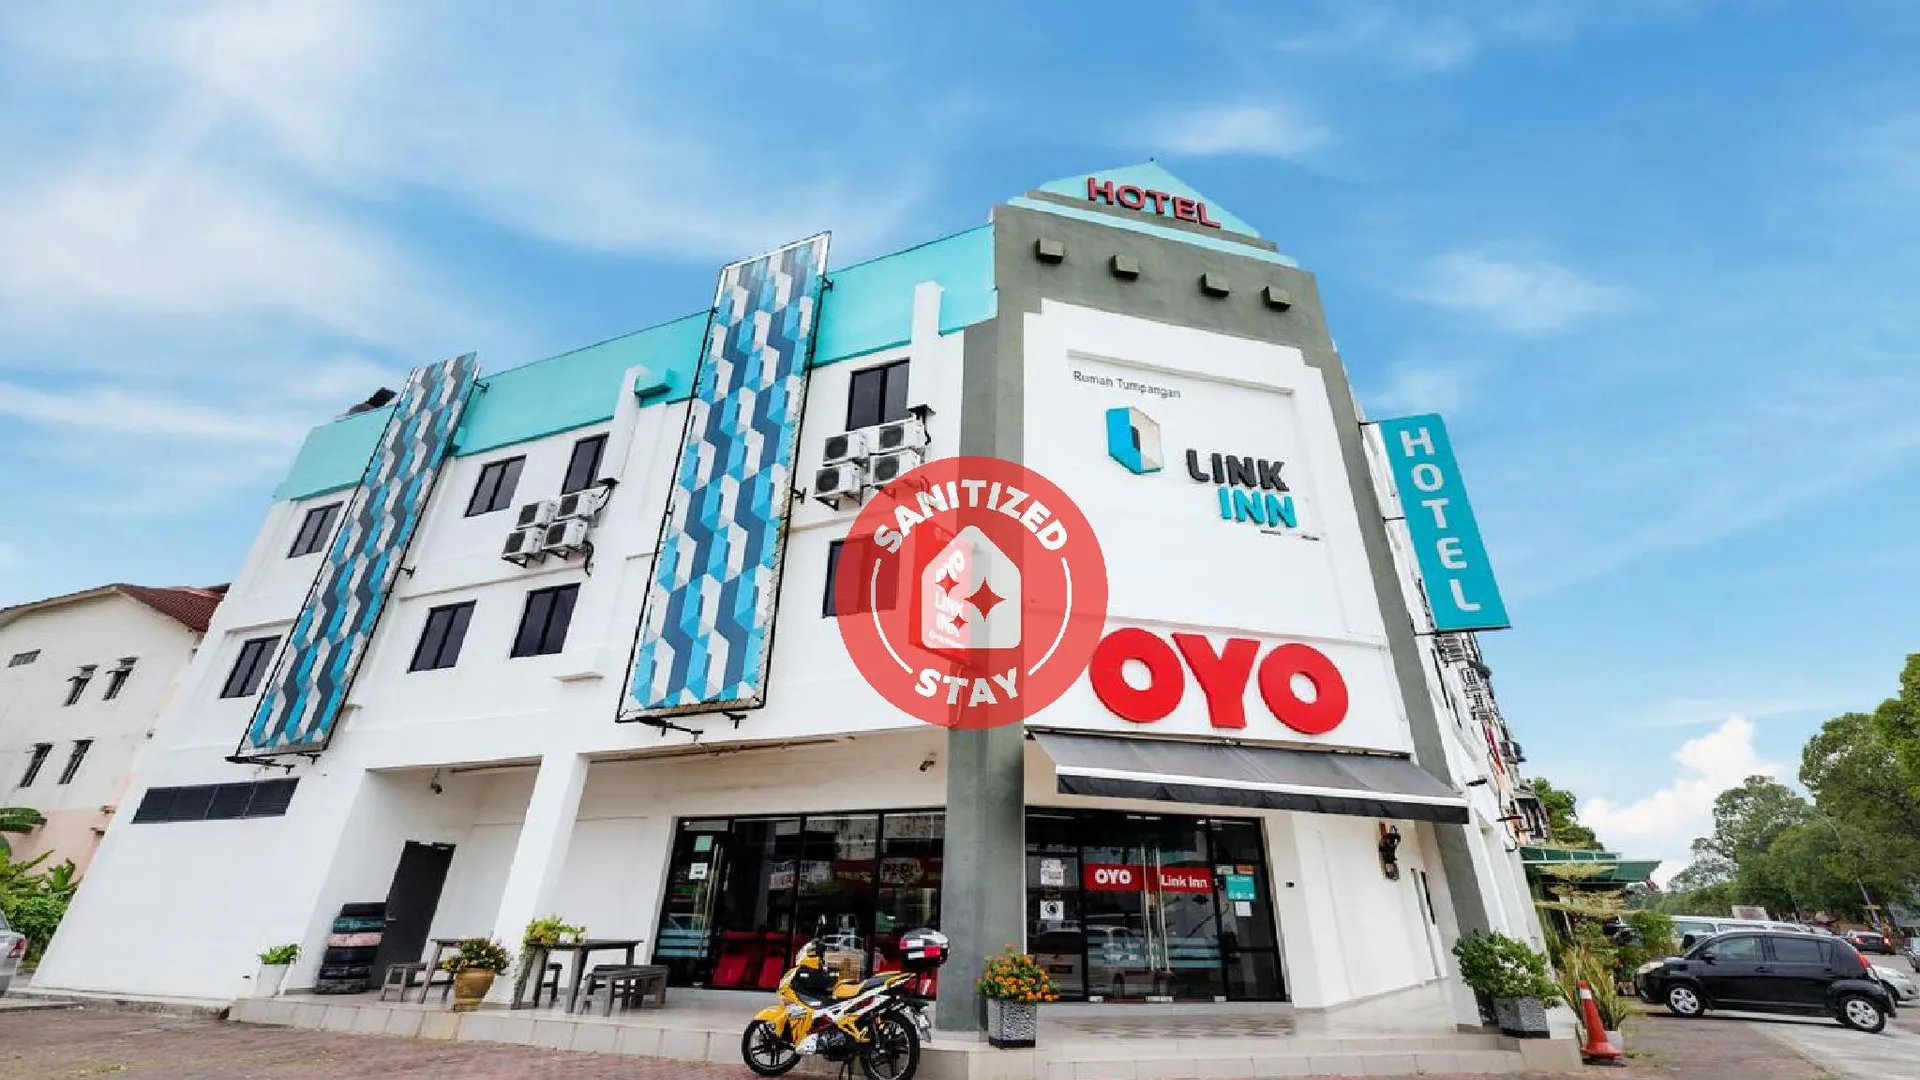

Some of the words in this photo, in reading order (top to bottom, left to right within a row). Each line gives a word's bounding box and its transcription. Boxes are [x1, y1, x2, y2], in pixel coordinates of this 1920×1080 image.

[1087, 177, 1221, 228] HOTEL
[1072, 370, 1113, 388] Rumah
[1115, 377, 1181, 399] Tumpangan
[1185, 448, 1290, 492] LINK
[1217, 487, 1298, 528] INN
[1400, 427, 1482, 612] HOTEL
[1089, 627, 1349, 735] OYO
[1094, 868, 1132, 885] OYO
[1161, 874, 1187, 887] Link
[1189, 877, 1208, 888] Inn
